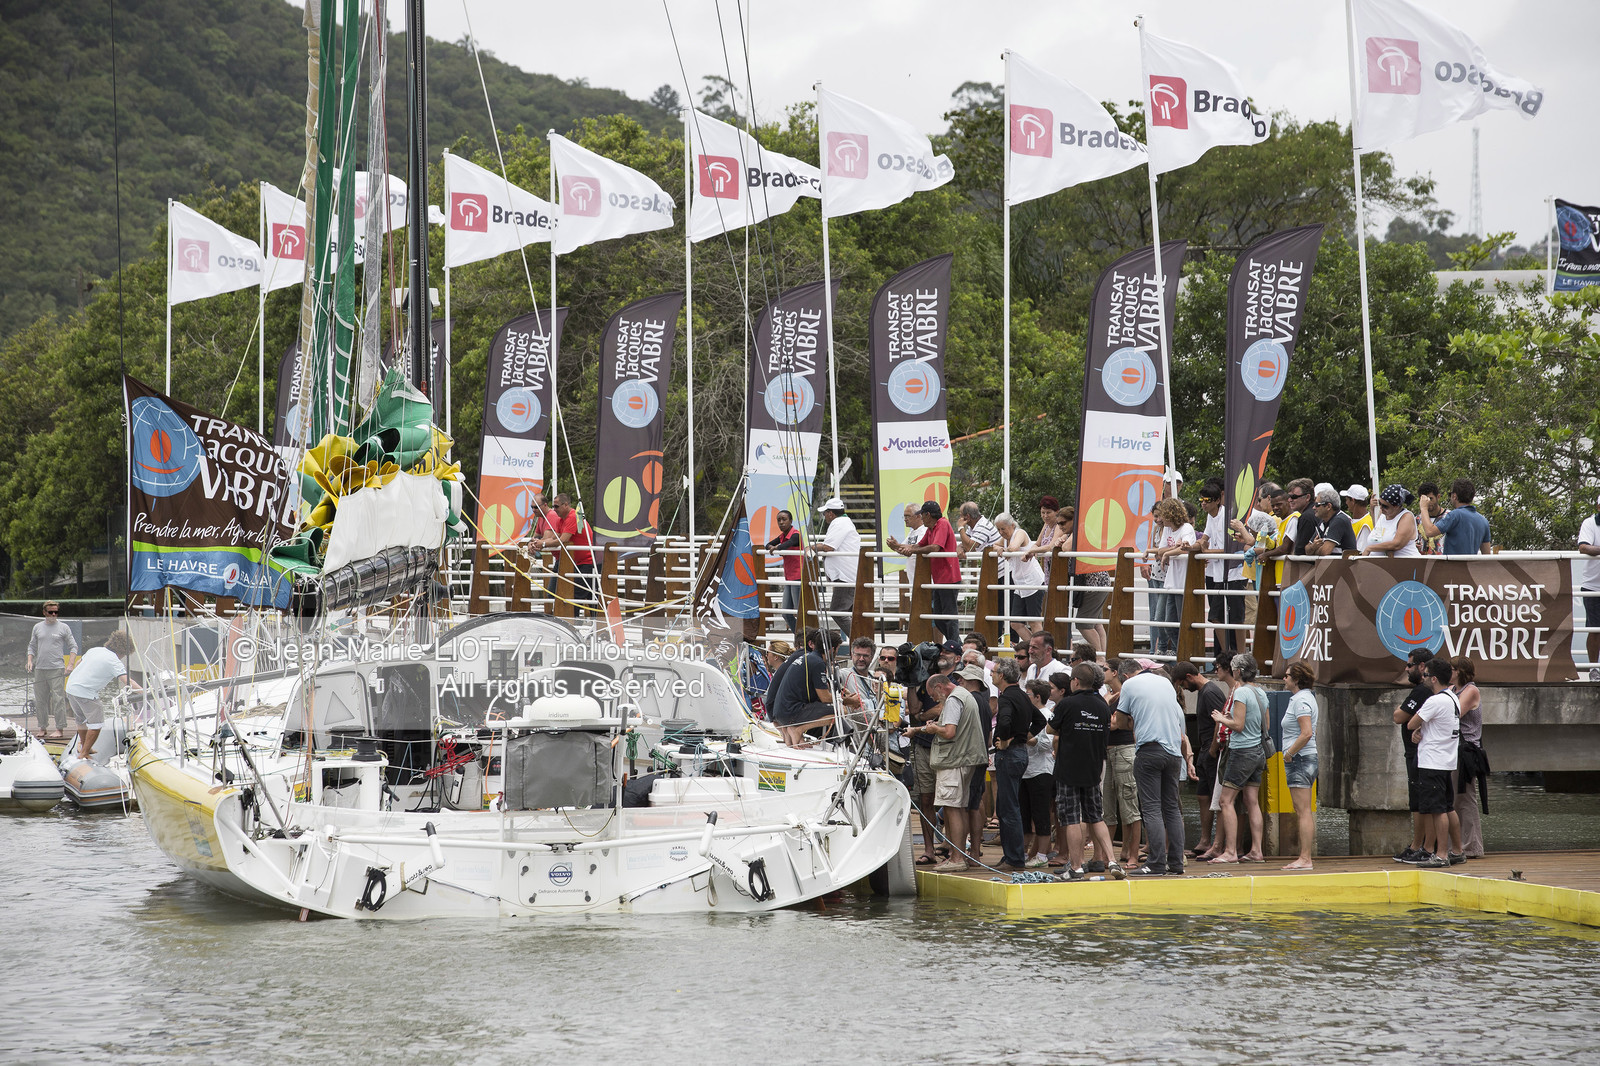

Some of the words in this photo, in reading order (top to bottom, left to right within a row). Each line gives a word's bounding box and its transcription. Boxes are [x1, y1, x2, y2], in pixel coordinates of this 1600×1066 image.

[1107, 270, 1126, 347] TRANSAT
[1121, 275, 1140, 346] Jacques
[1134, 272, 1167, 354] VABRE
[1245, 258, 1262, 339] TRANSAT
[1258, 263, 1277, 338] Jacques
[1271, 259, 1304, 345] VABRE
[1562, 278, 1572, 286] LE
[500, 328, 518, 387] TRANSAT
[615, 316, 630, 380] TRANSAT
[626, 320, 643, 379] Jacques
[637, 318, 666, 385] VABRE
[768, 306, 785, 373] TRANSAT
[781, 310, 798, 373] Jacques
[792, 307, 822, 379] VABRE
[887, 290, 900, 362] TRANSAT
[901, 293, 917, 358] Jacques
[915, 287, 938, 365] VABRE
[511, 331, 530, 387] Jacques
[522, 329, 551, 392] VABRE
[905, 447, 942, 455] International
[133, 512, 179, 538] Prendre
[179, 516, 191, 539] la
[147, 557, 163, 570] LE
[168, 559, 218, 575] HAVRE
[1443, 584, 1545, 601] TRANSAT
[1439, 624, 1550, 661] VABRE
[1449, 602, 1542, 627] Jacques
